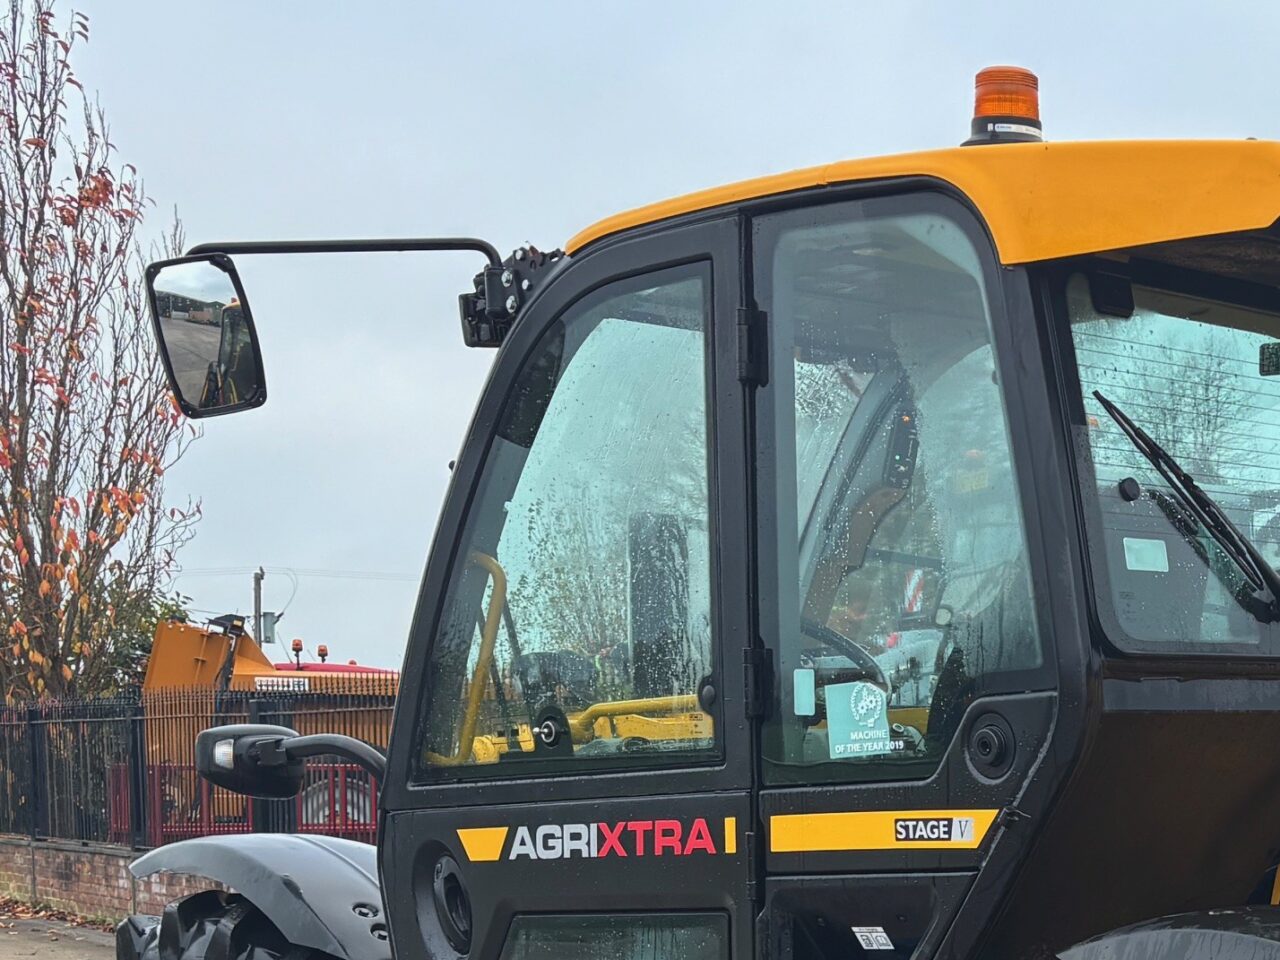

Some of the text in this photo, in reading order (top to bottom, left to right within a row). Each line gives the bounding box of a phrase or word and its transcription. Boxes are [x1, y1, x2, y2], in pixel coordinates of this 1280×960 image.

[850, 730, 888, 740] MACHINE
[835, 740, 904, 754] OF THE YEAR 2019
[896, 820, 969, 839] STAGE V
[509, 818, 717, 860] AGRIXTRA
